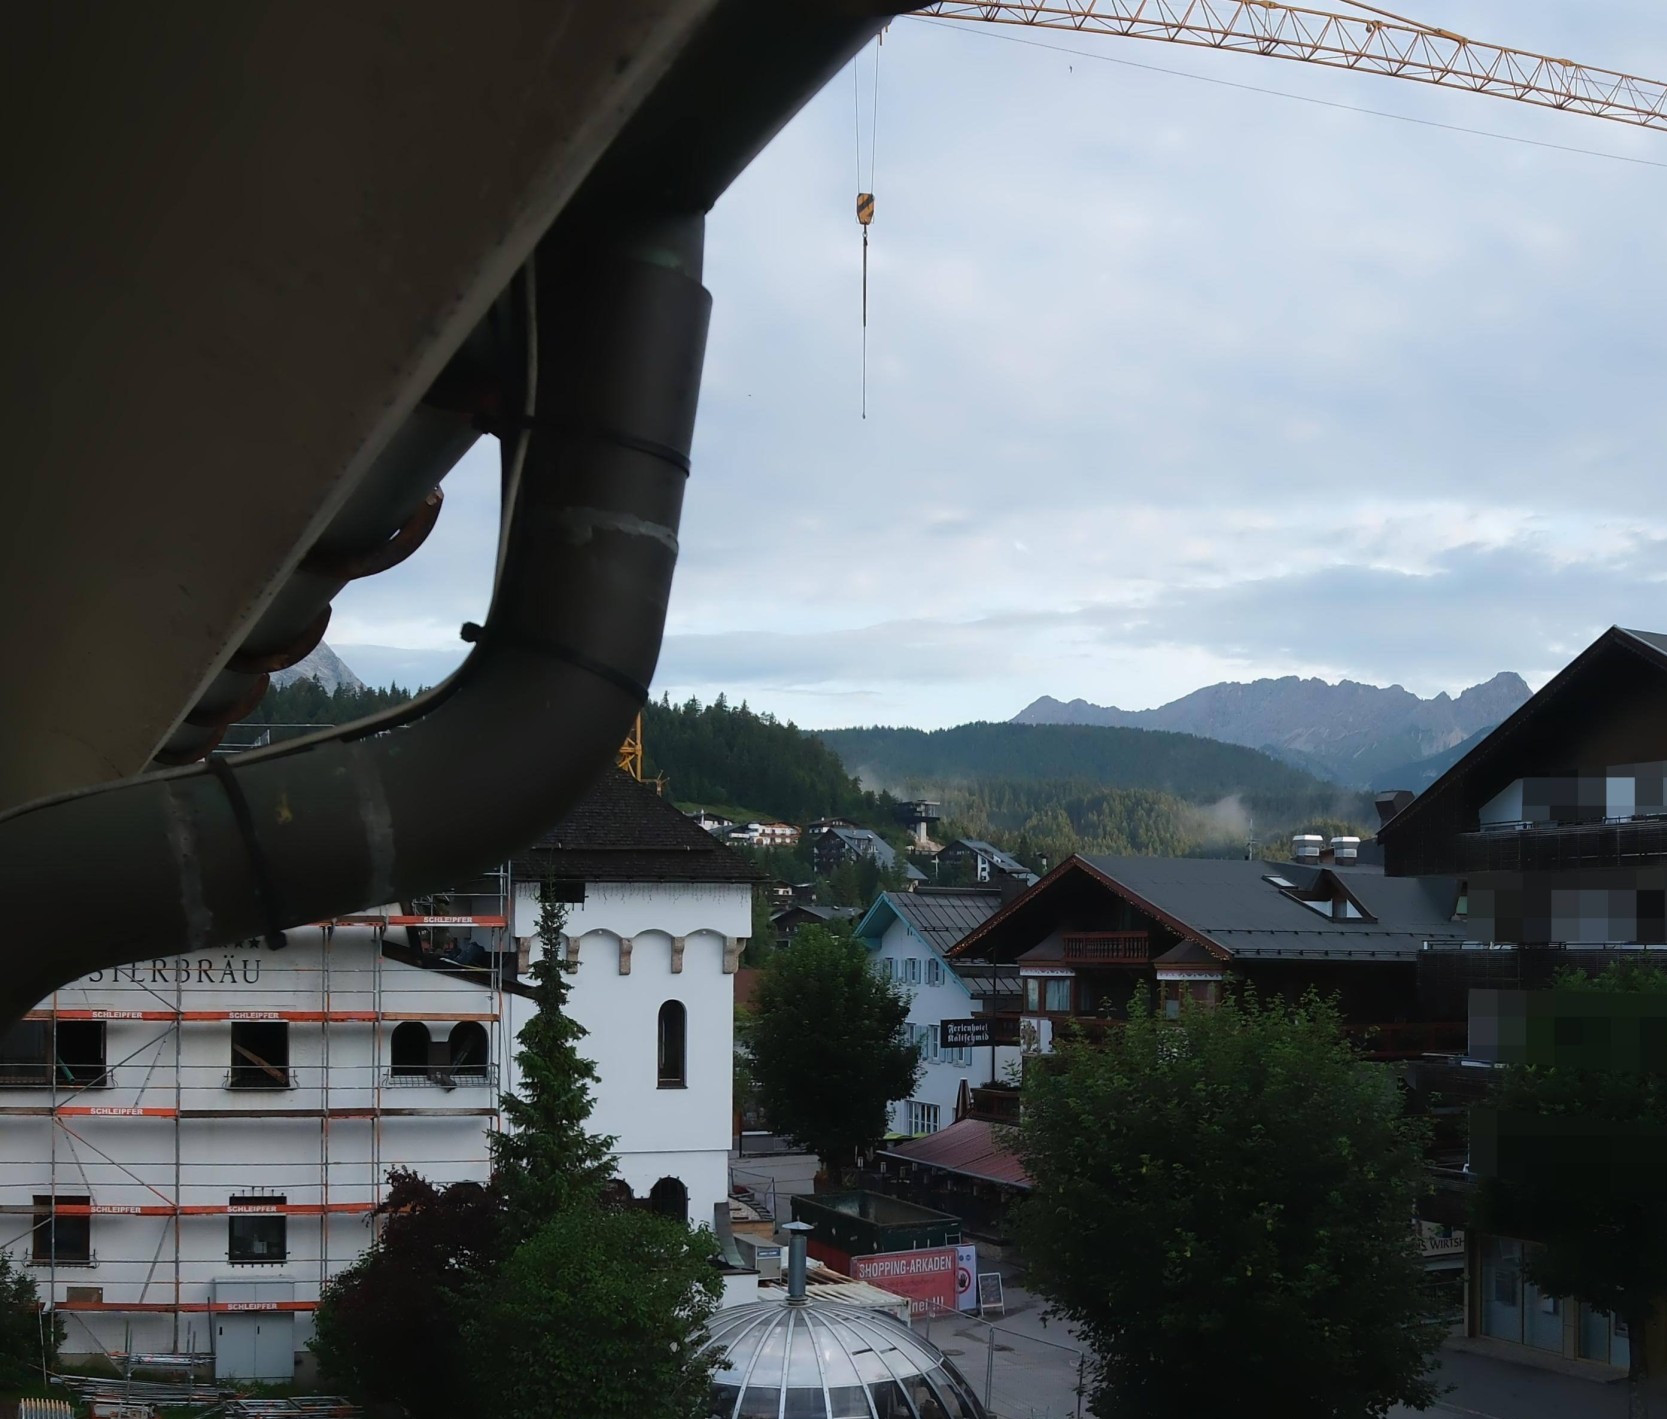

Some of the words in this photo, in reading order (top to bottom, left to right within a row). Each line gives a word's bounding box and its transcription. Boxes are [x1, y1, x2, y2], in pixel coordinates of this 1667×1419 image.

[92, 1011, 142, 1019] SCHLEIPFER
[229, 1012, 279, 1020] SCHLEIPFER
[90, 1107, 143, 1116] SCHLEIPFER
[90, 1206, 141, 1214] SCHLEIPFER
[227, 1205, 277, 1213] SCHLEIPFER
[859, 1255, 952, 1278] SHOPPING-ARKADEN
[228, 1303, 278, 1311] SCHLEIPFER
